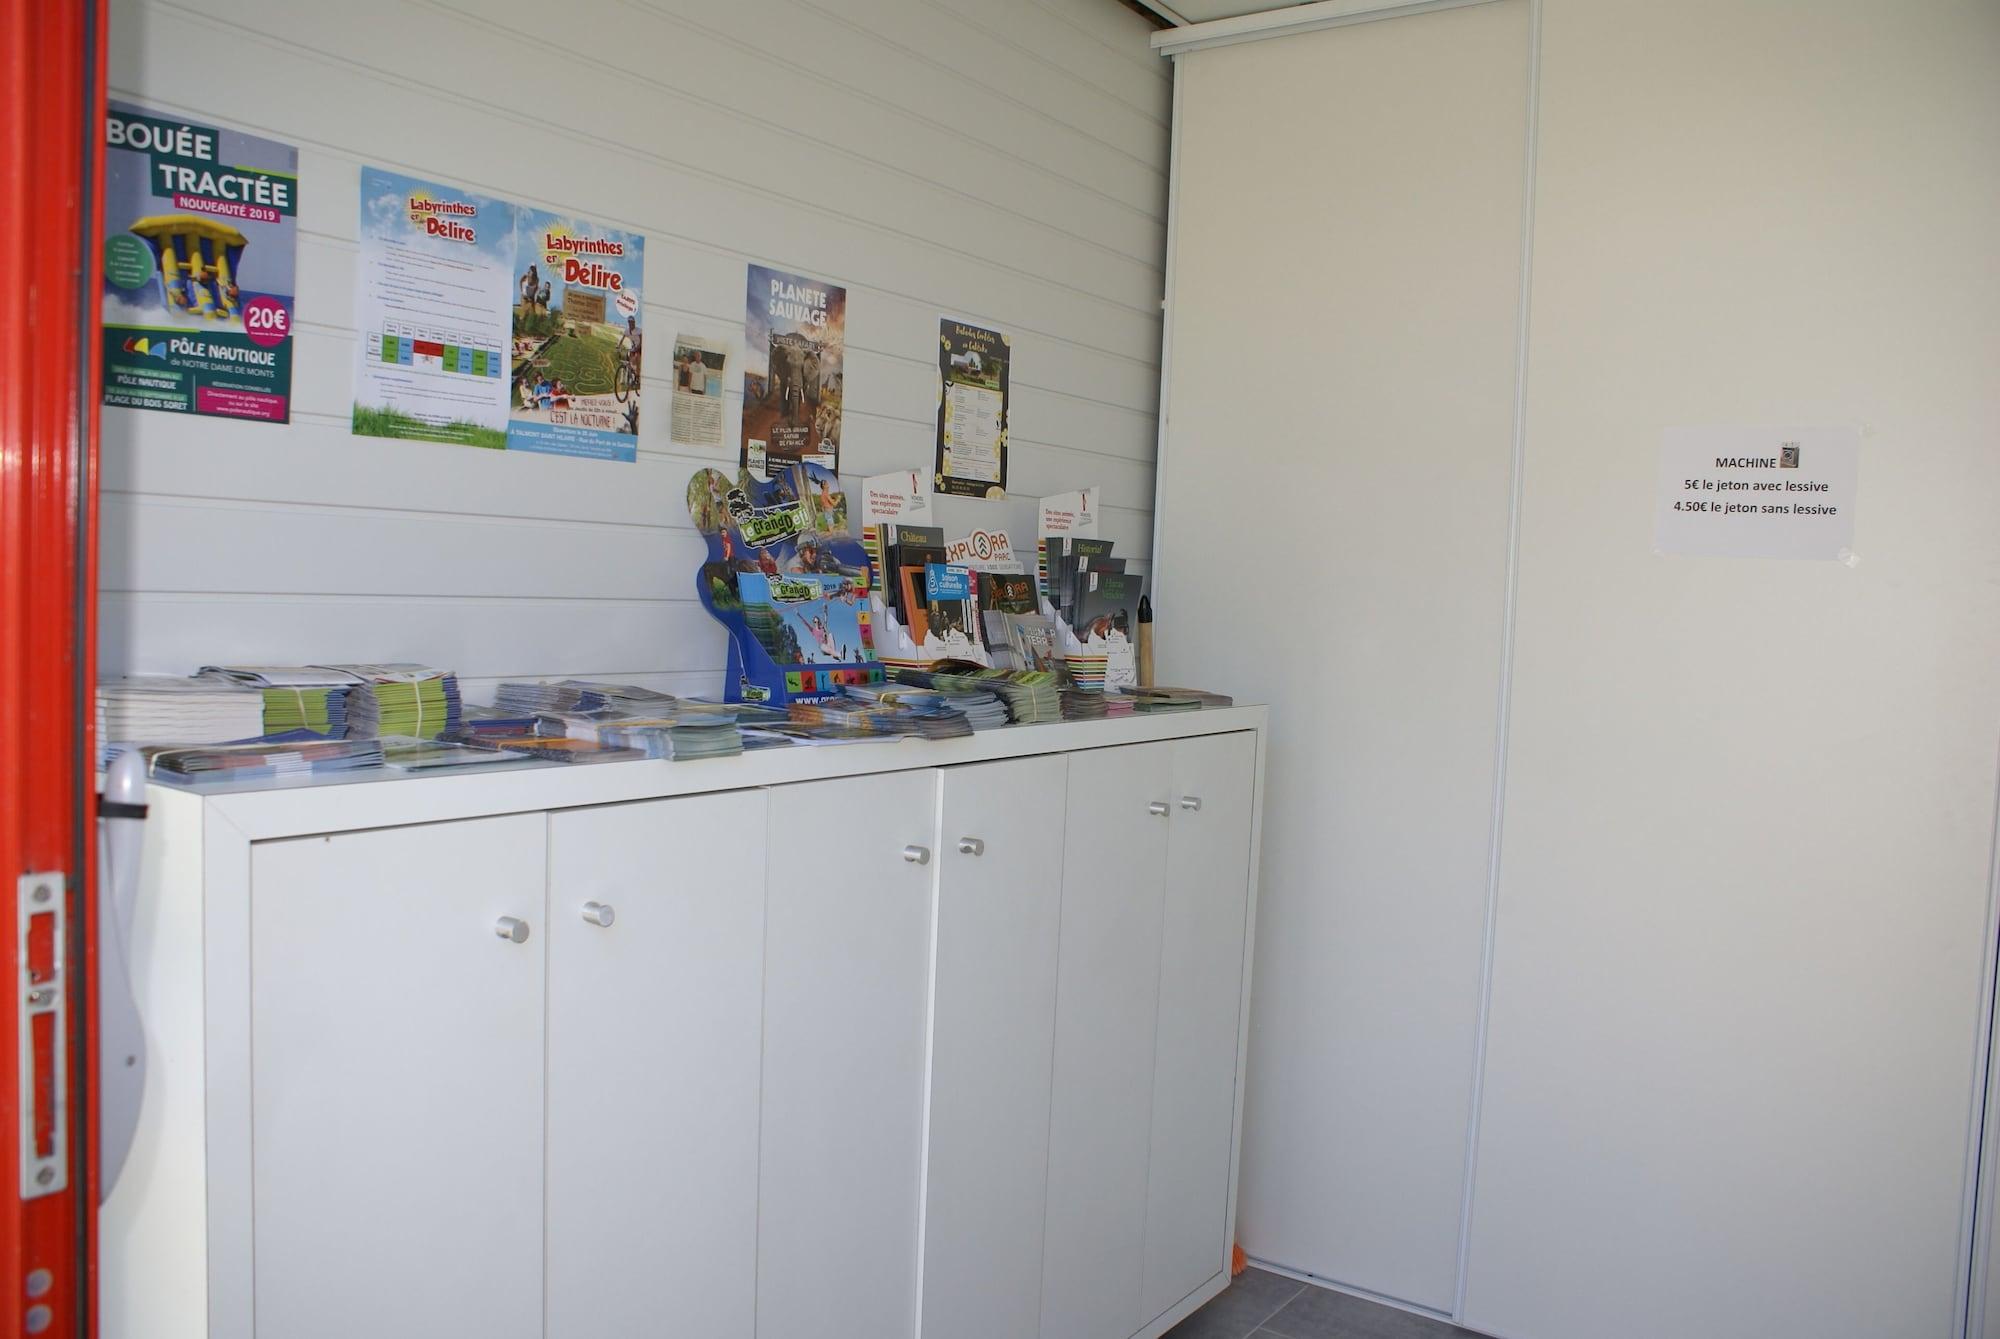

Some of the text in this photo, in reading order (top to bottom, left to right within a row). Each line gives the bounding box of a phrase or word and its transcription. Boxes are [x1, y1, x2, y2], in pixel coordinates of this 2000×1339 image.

[106, 118, 212, 161] BOUÉE
[158, 164, 289, 208] TRACTÉE
[179, 196, 276, 221] NOUVEAUTÉ 2019
[410, 198, 476, 215] Labyrinthes
[426, 217, 475, 242] Délire
[546, 233, 623, 255] Labyrinthes
[564, 258, 622, 290] Délire
[770, 279, 827, 309] PLANETE
[248, 307, 286, 330] 20€
[769, 299, 827, 328] SAUVAGE
[169, 337, 276, 367] PÔLE NAUTIQUE
[182, 360, 209, 371] NOTRE
[210, 363, 234, 373] DAME
[234, 366, 246, 374] DE
[246, 367, 275, 378] MONTS
[1715, 457, 1777, 468] MACHINE
[1684, 479, 1829, 492] 5€ le jeton avec lessive
[1673, 501, 1837, 515] 4.50€ le jeton sans lessive
